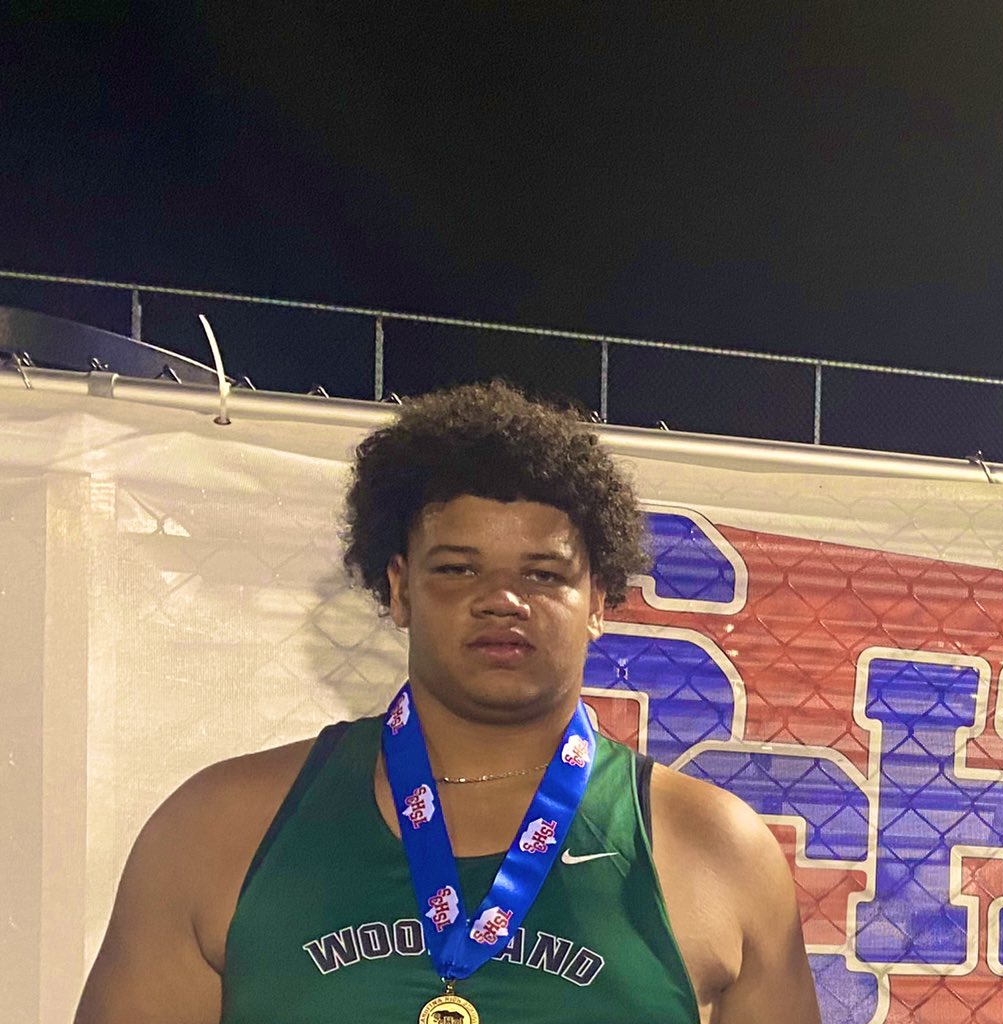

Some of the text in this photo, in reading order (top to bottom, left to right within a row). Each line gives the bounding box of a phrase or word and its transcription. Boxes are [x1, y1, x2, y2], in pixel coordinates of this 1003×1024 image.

[428, 888, 452, 932] SCHSL
[473, 909, 513, 944] SCHSL
[303, 918, 605, 987] WOOAND
